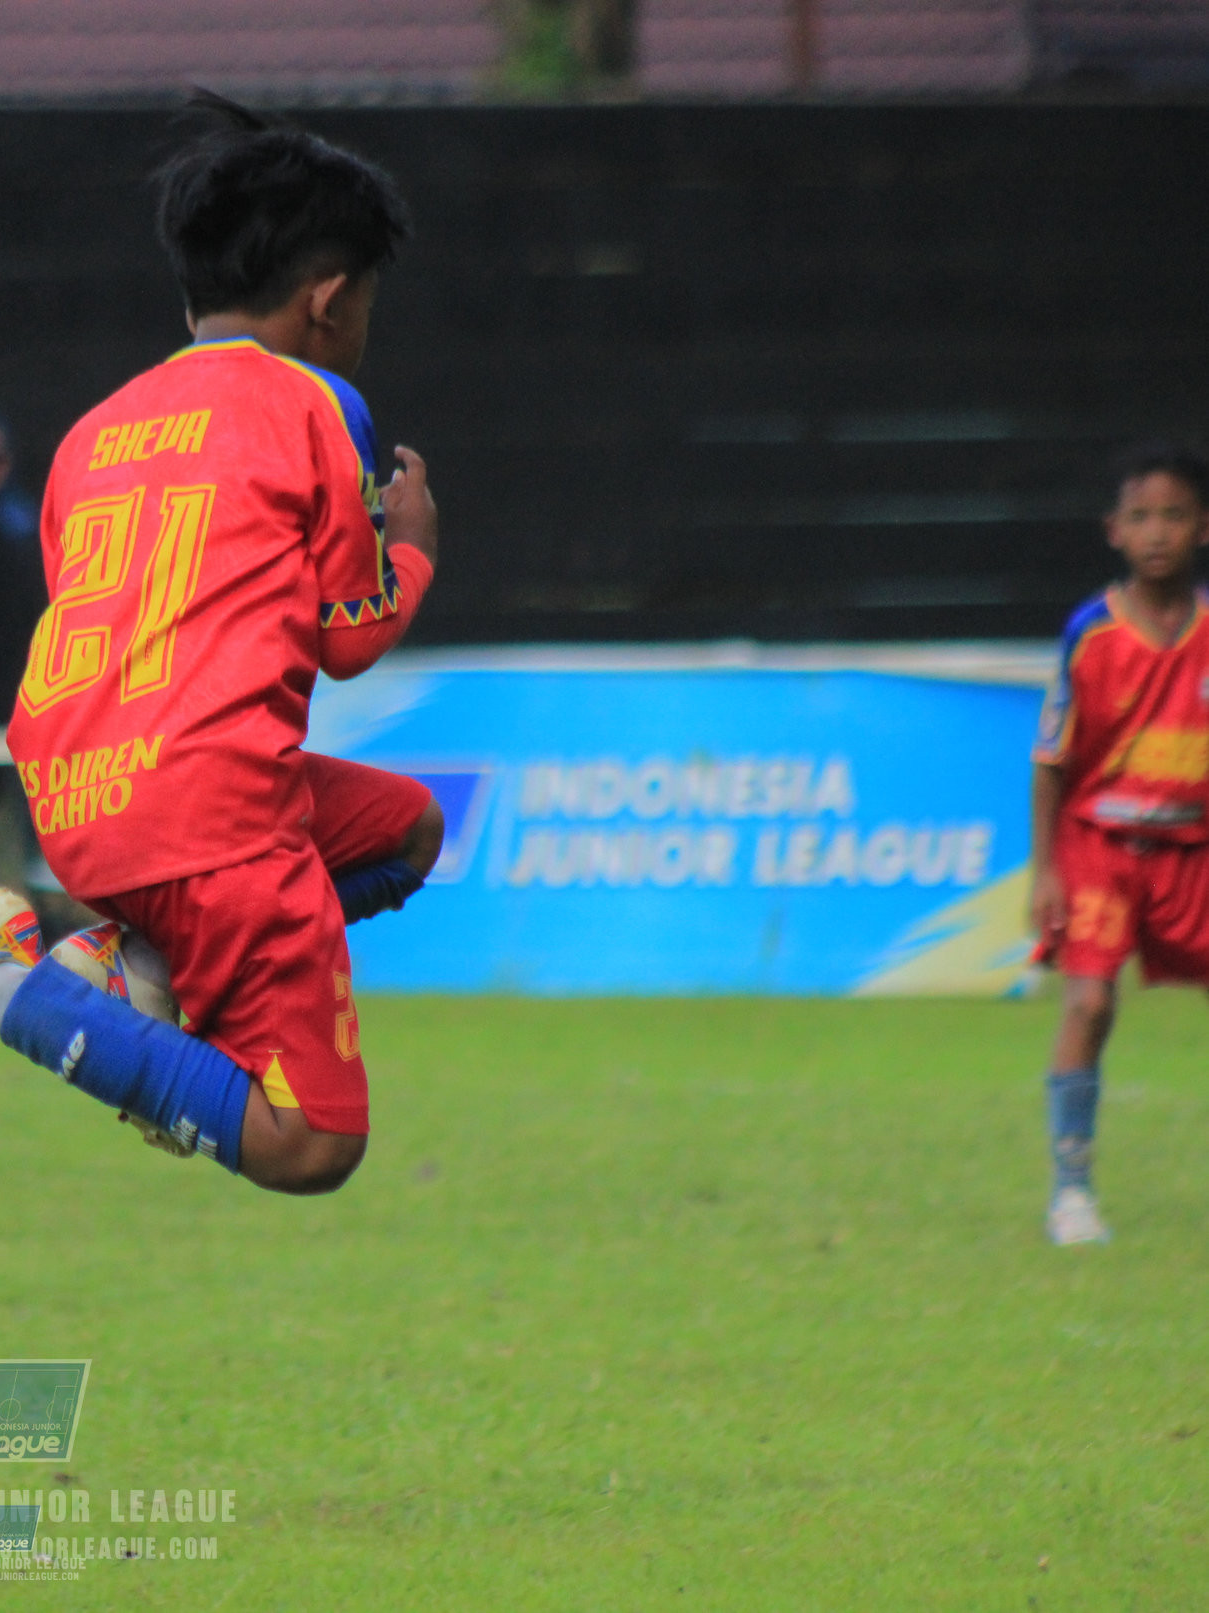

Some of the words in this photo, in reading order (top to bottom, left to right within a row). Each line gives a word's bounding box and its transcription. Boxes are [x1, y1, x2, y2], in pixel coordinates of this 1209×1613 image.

[19, 484, 217, 718] 21
[48, 734, 165, 795] DUREN
[520, 757, 855, 819] INDONESIA
[35, 777, 133, 835] CAHYO
[504, 825, 737, 888] JUNIOR
[755, 822, 992, 888] LEAGUE
